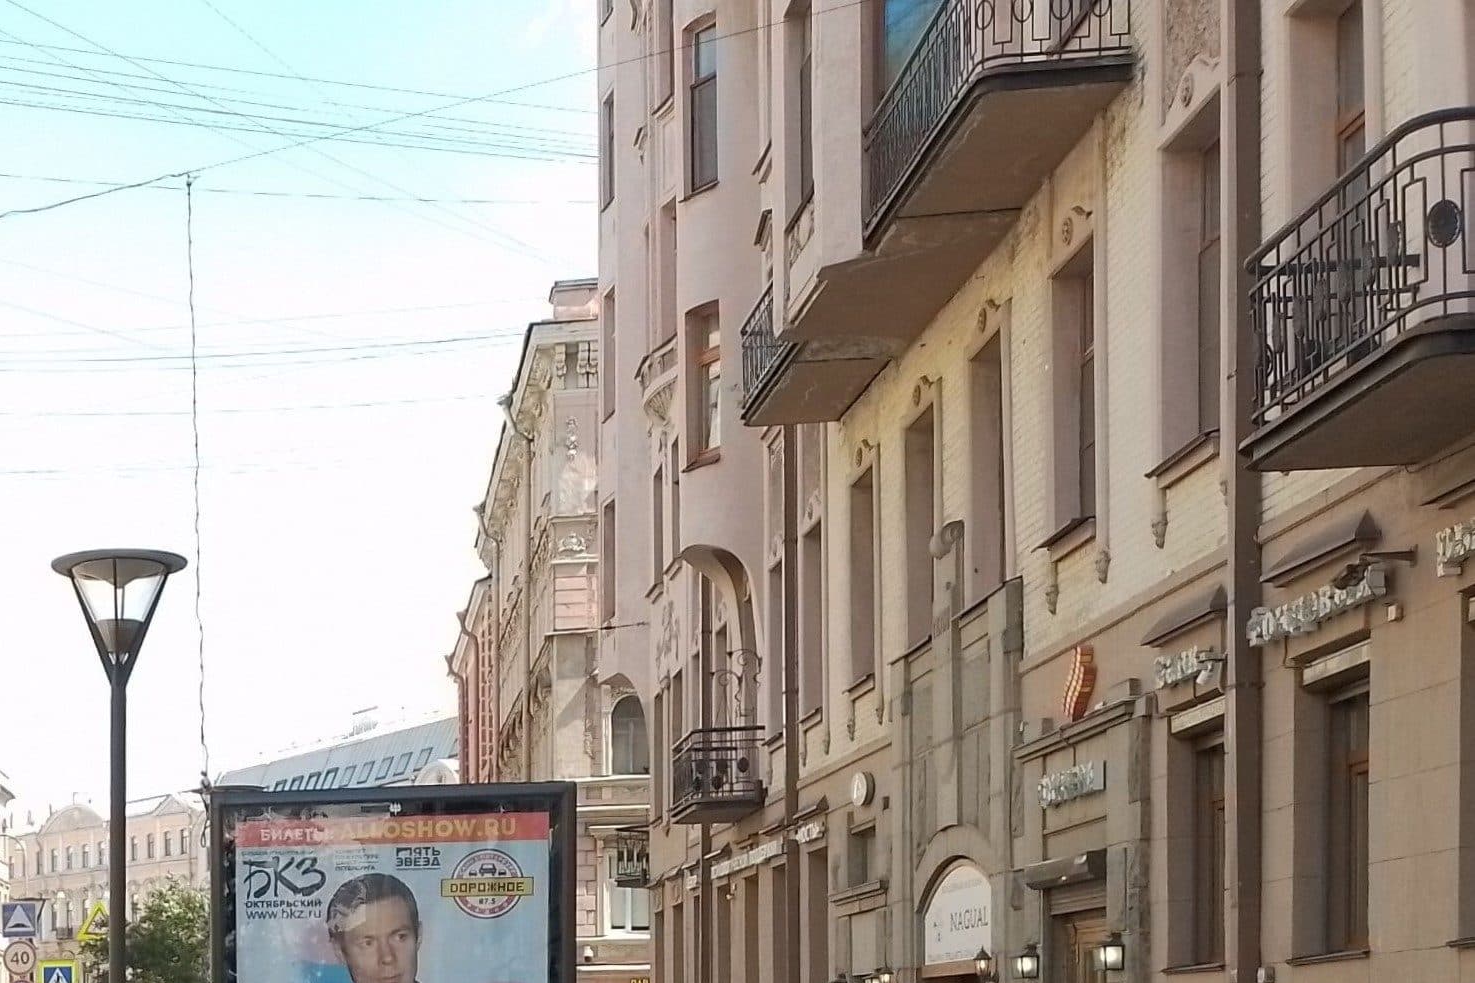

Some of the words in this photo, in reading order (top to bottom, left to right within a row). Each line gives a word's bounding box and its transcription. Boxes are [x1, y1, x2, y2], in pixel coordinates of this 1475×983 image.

[396, 846, 441, 857] ПЯТЬ
[396, 856, 441, 867] ЗВЕЗД
[242, 856, 327, 899] БКЗ
[450, 881, 524, 893] ДОРОЖНОЕ
[244, 900, 323, 909] ОКТЯБРЬСКИЙ
[246, 908, 322, 919] www.bkz.ru
[949, 905, 989, 932] NAGUAL
[10, 953, 30, 965] 40
